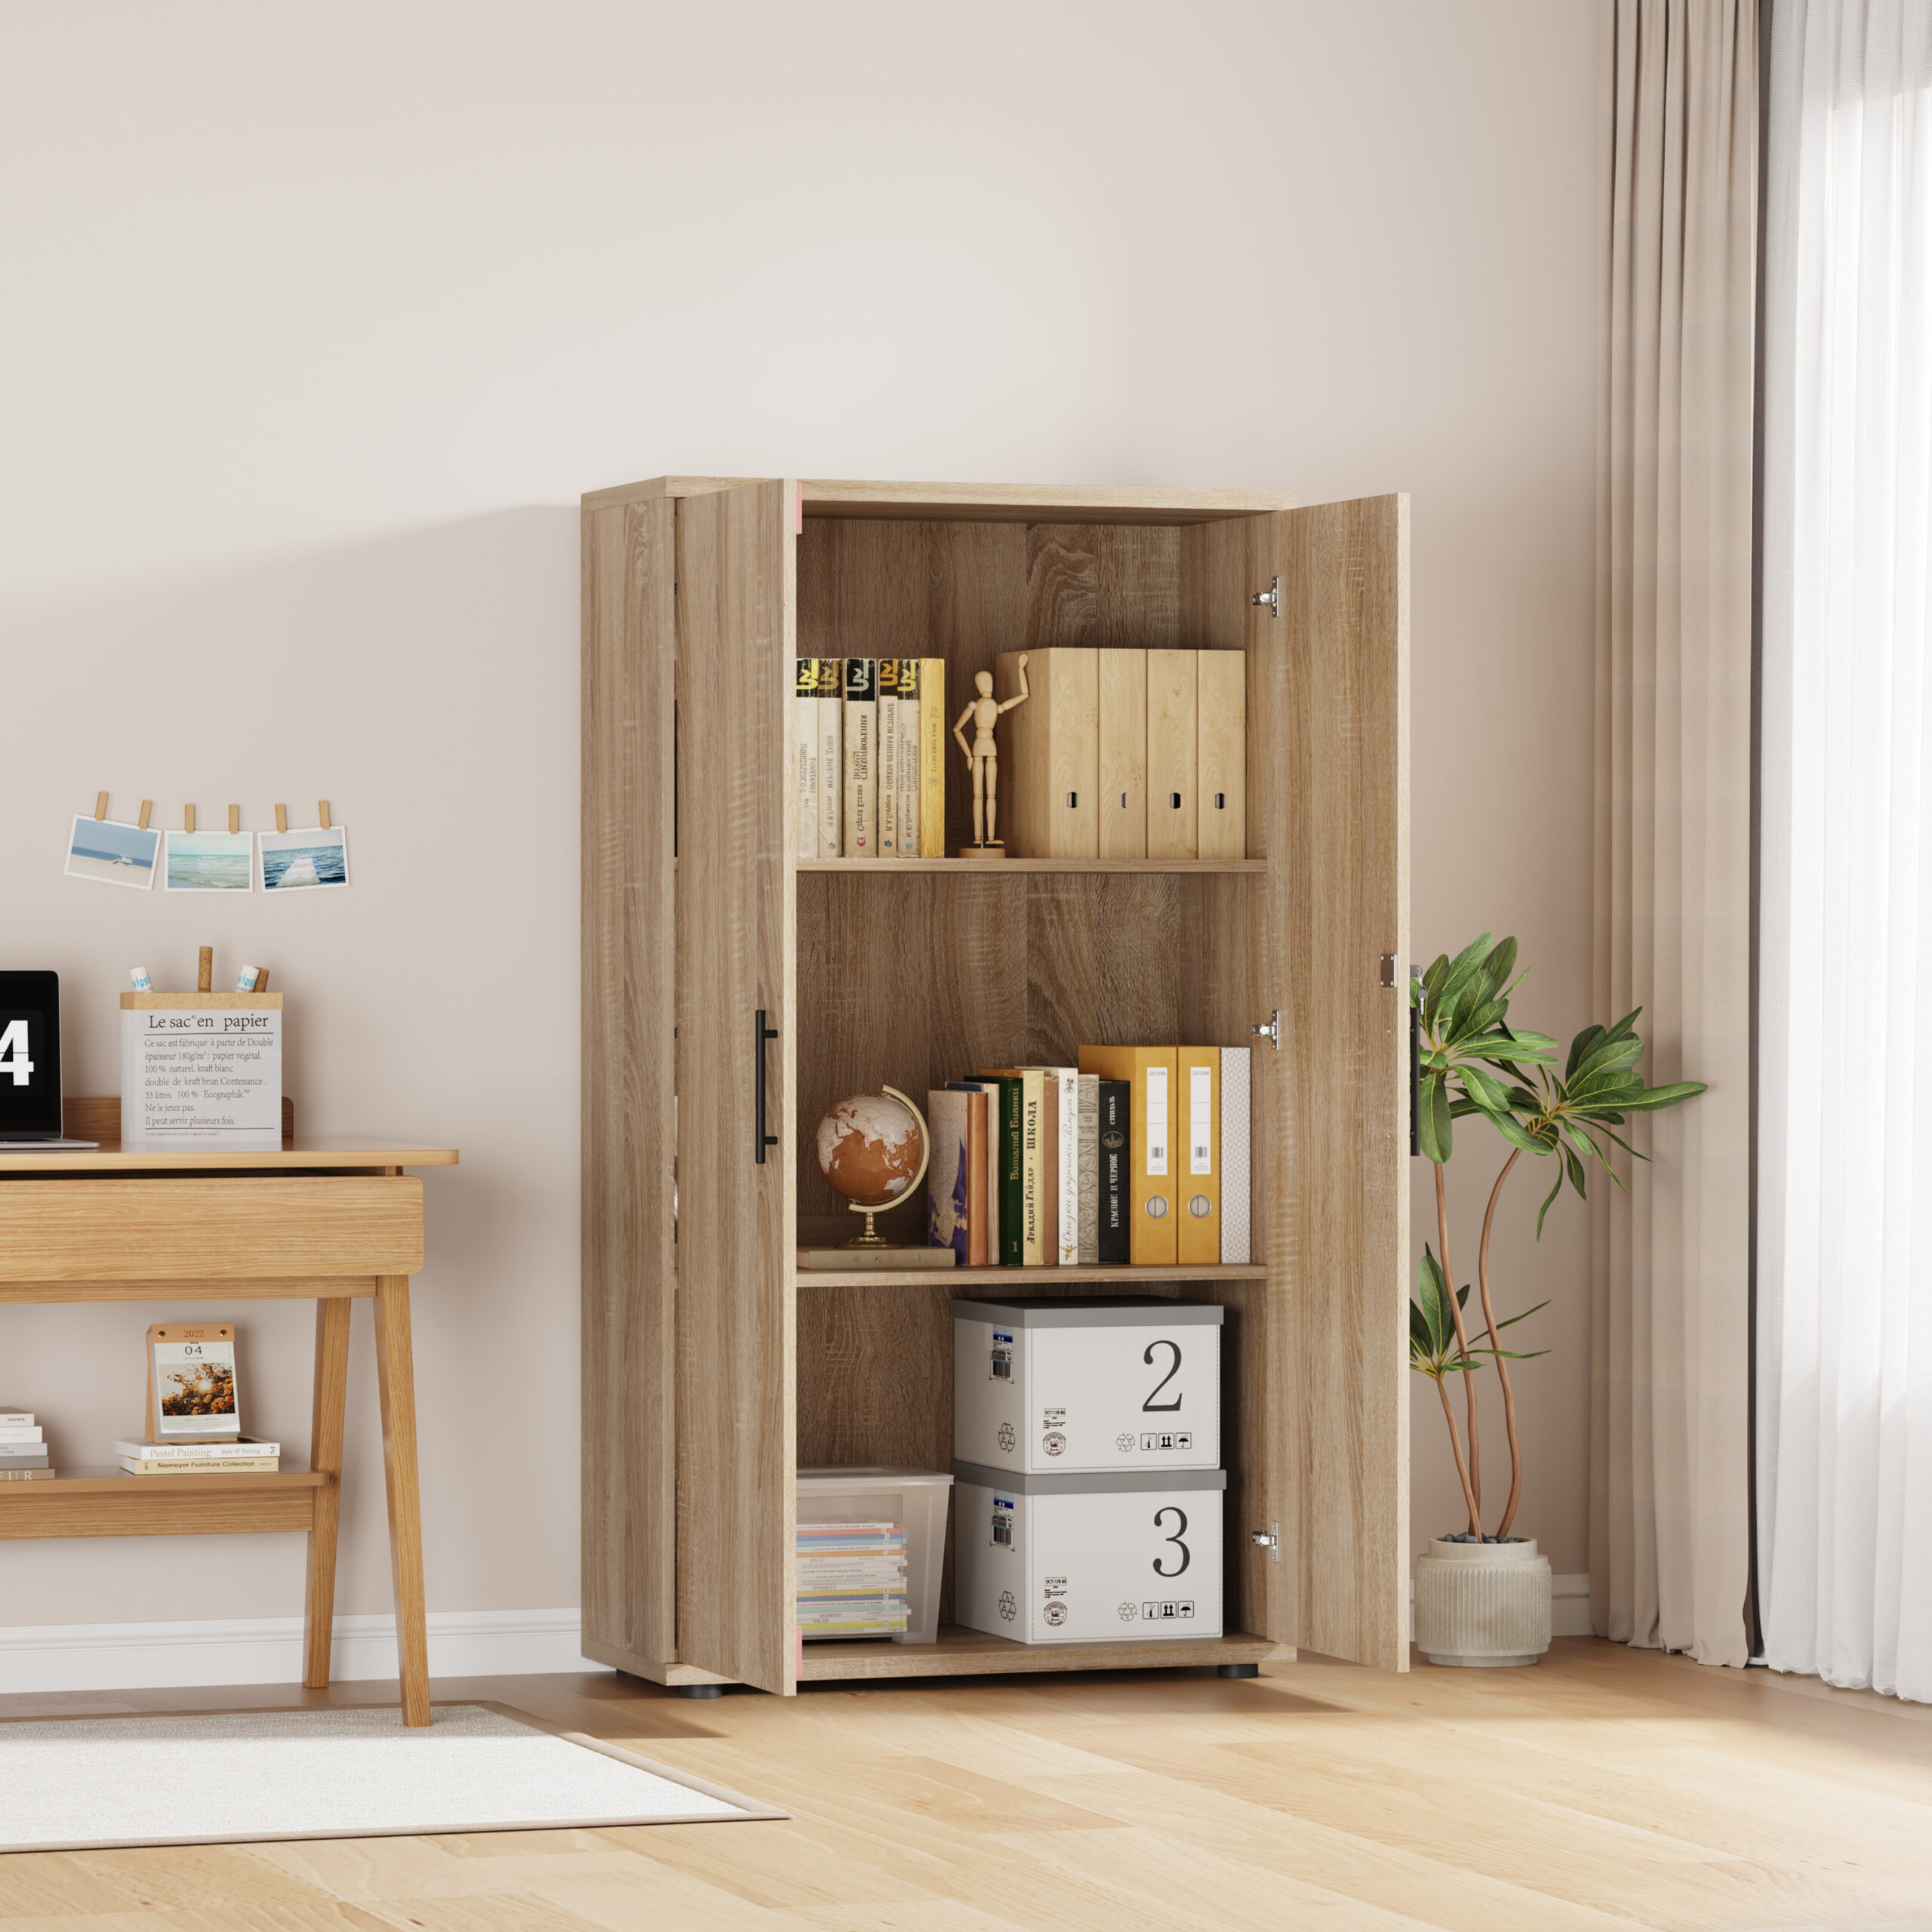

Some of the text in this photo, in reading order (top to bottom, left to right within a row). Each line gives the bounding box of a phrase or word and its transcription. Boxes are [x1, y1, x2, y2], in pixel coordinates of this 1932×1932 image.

[149, 1015, 166, 1028] Le
[197, 1017, 214, 1027] en
[223, 1014, 269, 1031] papier
[144, 1039, 155, 1048] Ce
[180, 1038, 208, 1048] fabriqué
[217, 1038, 235, 1049] partir
[237, 1038, 246, 1046] de
[248, 1038, 273, 1046] Double
[0, 1020, 34, 1086] 4
[145, 1052, 176, 1062] épaisseur
[213, 1052, 235, 1062] papier
[236, 1051, 262, 1062] végétal.
[146, 1065, 157, 1073] 100
[198, 1063, 214, 1072] kraft
[215, 1063, 233, 1072] blanc
[173, 1077, 181, 1085] de
[185, 1077, 201, 1085] kraft
[202, 1077, 219, 1085] brun
[220, 1077, 263, 1085] Contenance
[155, 1091, 173, 1099] litres.
[164, 1104, 180, 1114] jetez
[183, 1106, 195, 1114] pas.
[146, 1115, 235, 1127] Il peut servir plusieurs fois.
[1026, 1101, 1037, 1150] ШКОЛА
[1010, 1088, 1019, 1181] Виталий Бианки
[1109, 1153, 1118, 1183] ЧЕРНОЕ
[1110, 1194, 1118, 1228] КРАСНОЕ
[1063, 1199, 1076, 1241] Сказки
[1012, 1241, 1018, 1252] 1
[184, 1329, 205, 1338] 2022
[185, 1346, 202, 1355] 04
[1143, 1340, 1183, 1412] 2
[150, 1448, 211, 1459] Pastel Painting
[1152, 1506, 1191, 1577] 3
